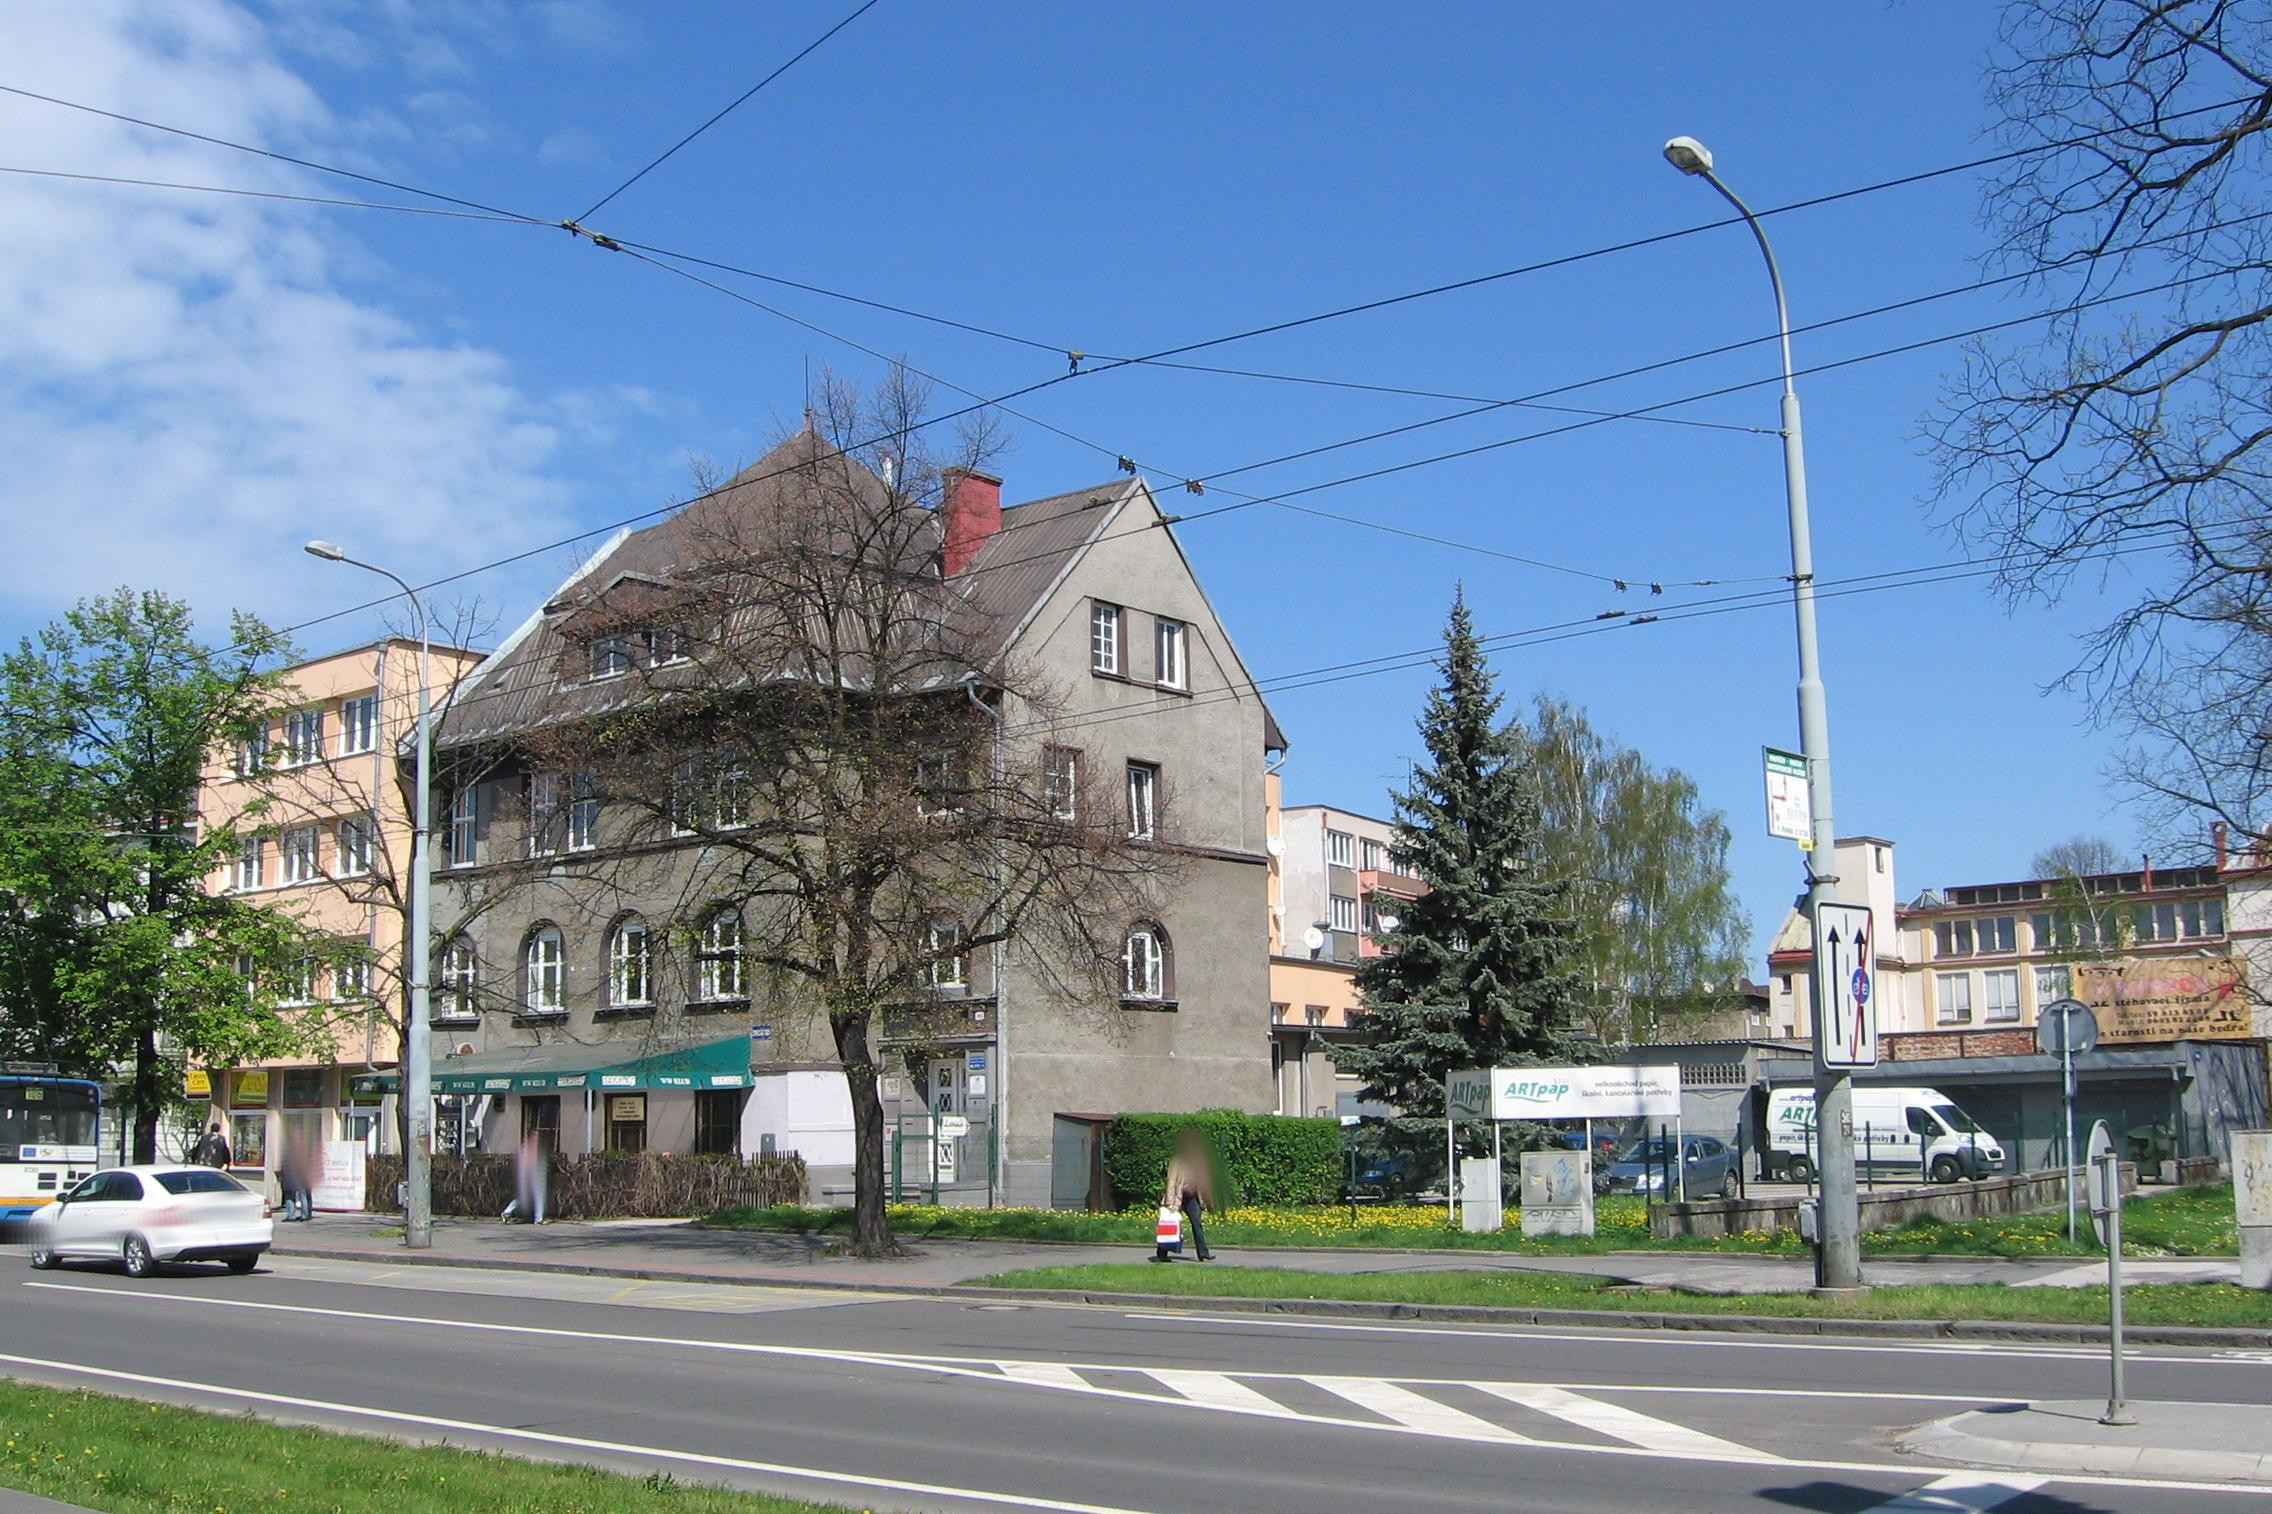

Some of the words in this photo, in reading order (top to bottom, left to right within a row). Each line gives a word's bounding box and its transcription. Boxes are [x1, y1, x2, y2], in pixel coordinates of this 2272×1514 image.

[2110, 1028, 2155, 1037] starosti
[2179, 1025, 2204, 1033] naše
[2209, 1023, 2248, 1033] bedra!
[1504, 1082, 1569, 1101] ARTpap
